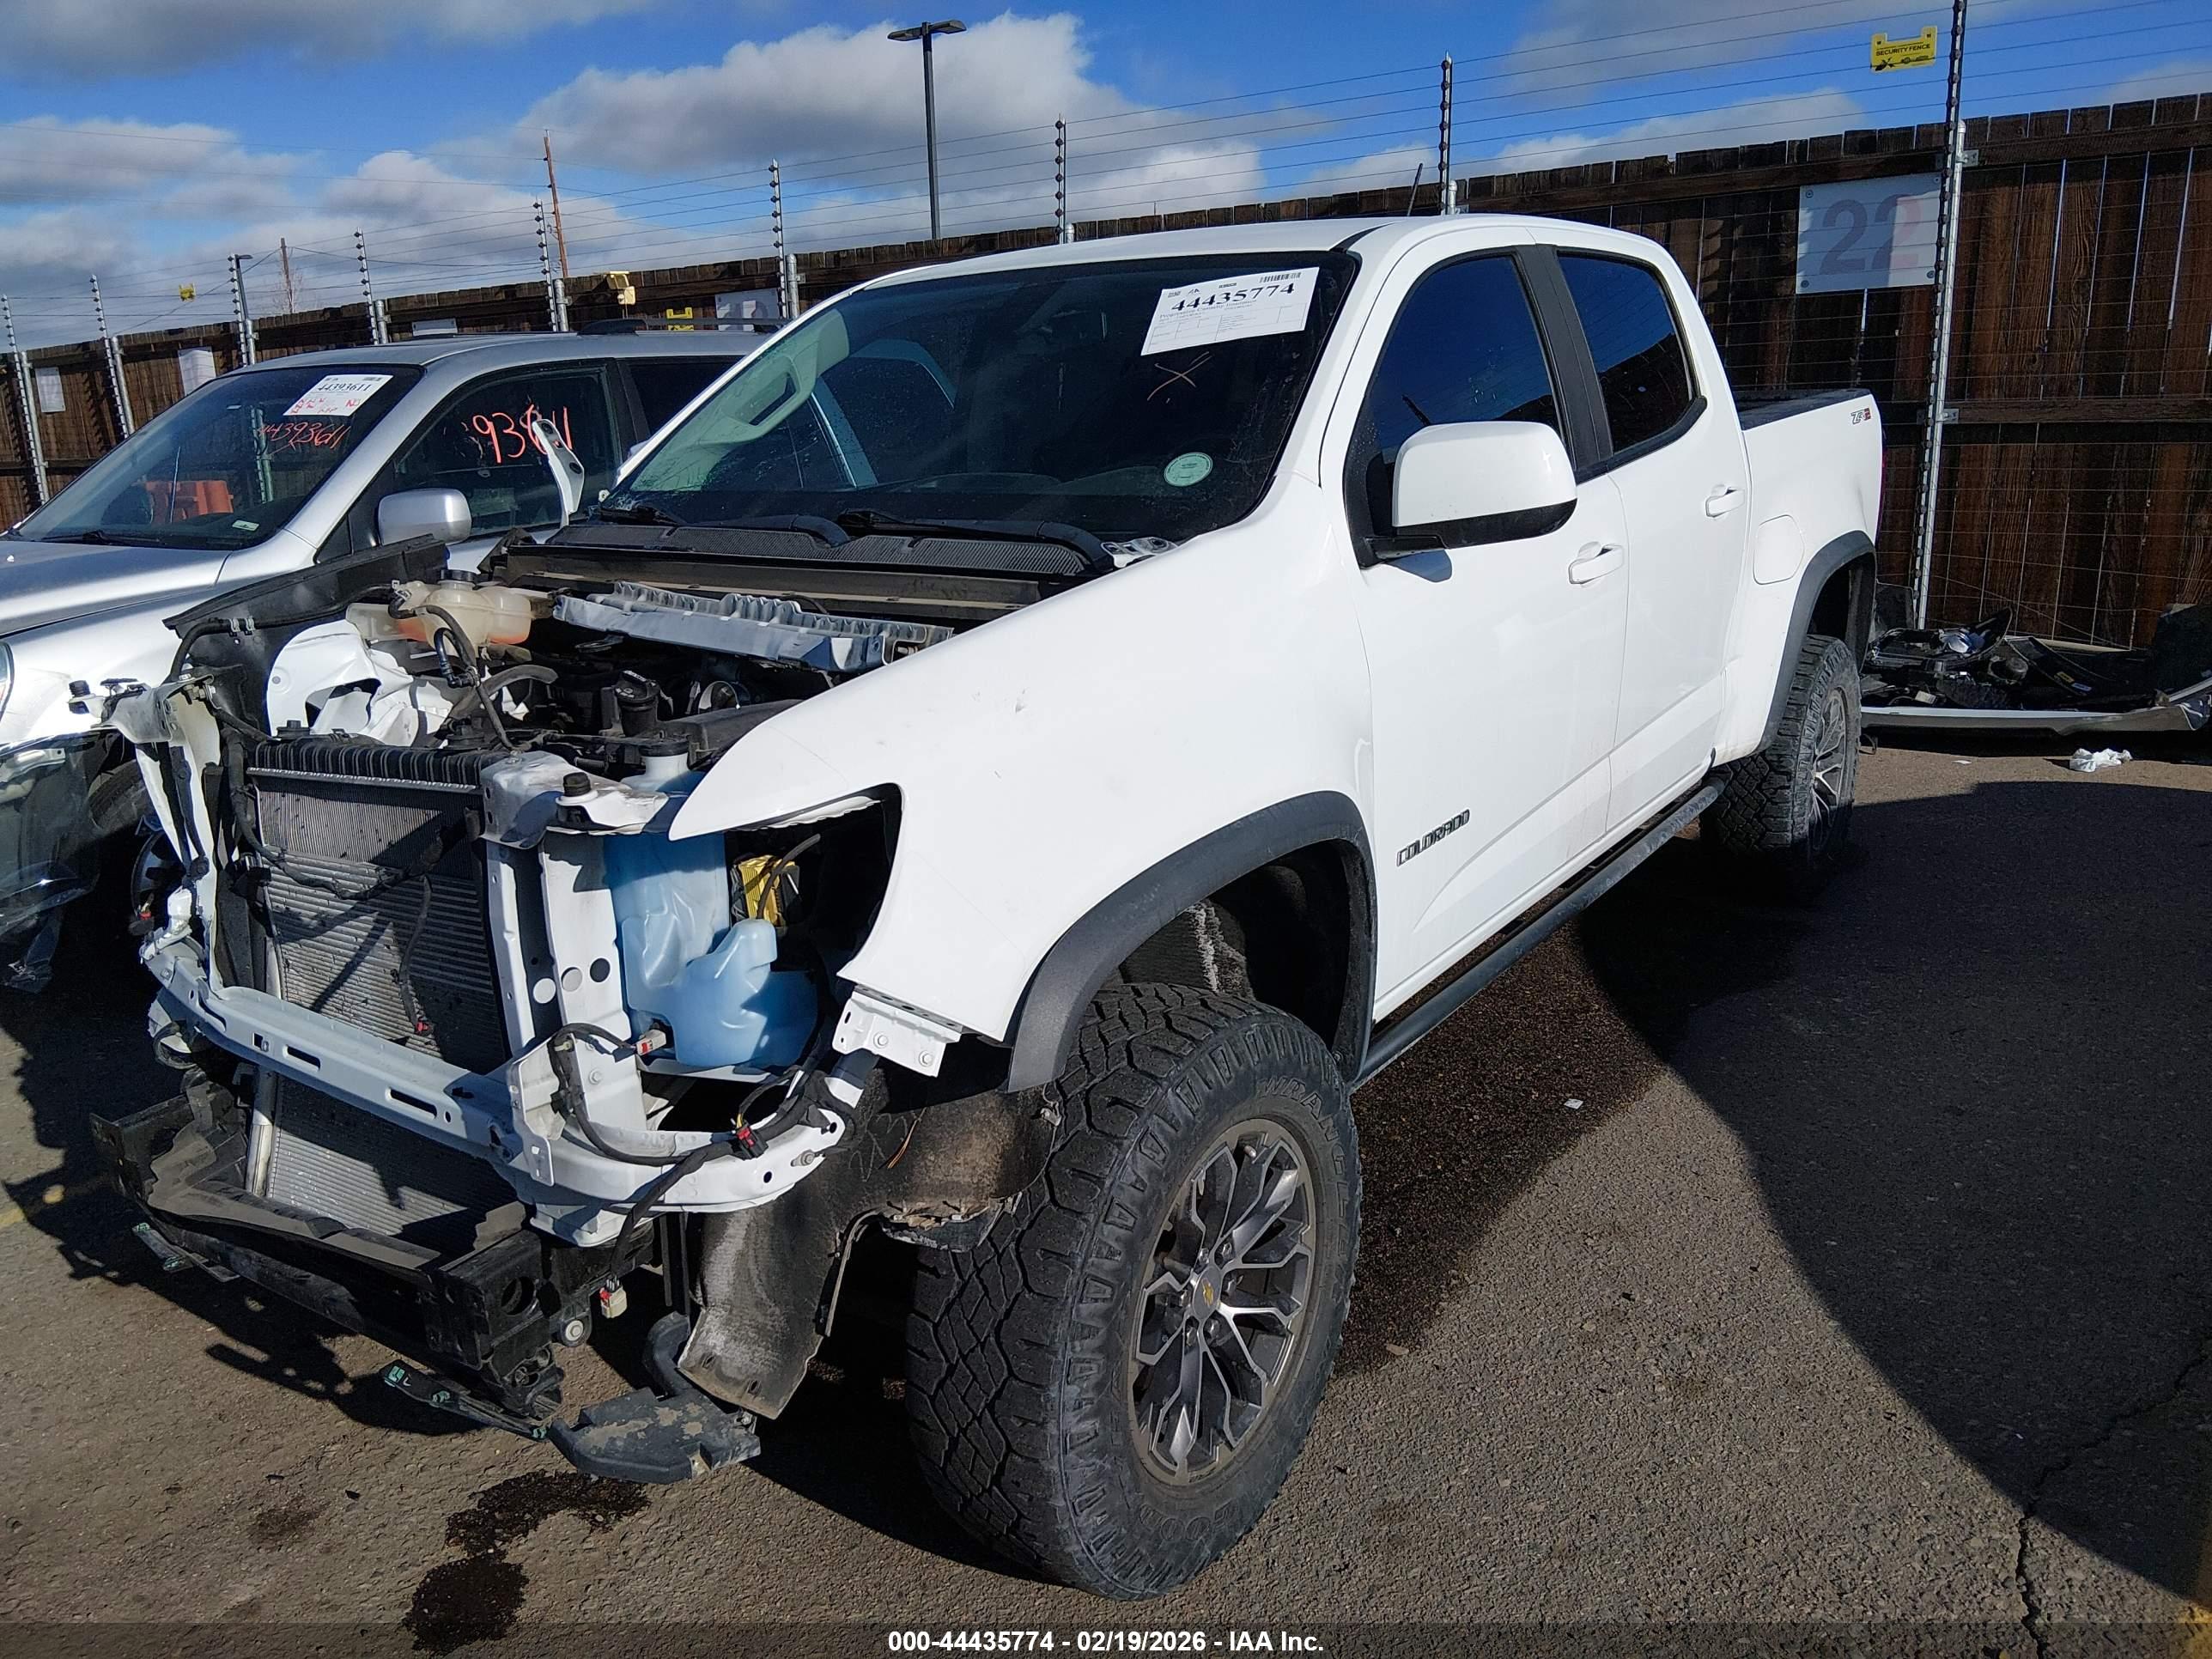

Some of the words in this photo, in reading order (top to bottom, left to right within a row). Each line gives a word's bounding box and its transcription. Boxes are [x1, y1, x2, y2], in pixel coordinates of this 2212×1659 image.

[1875, 47, 1908, 57] SECURITY
[1909, 43, 1931, 52] FENCE
[1819, 194, 1921, 275] 22
[1171, 283, 1295, 311] 44435774
[317, 383, 372, 392] 44393611
[1396, 809, 1470, 867] COLORADO
